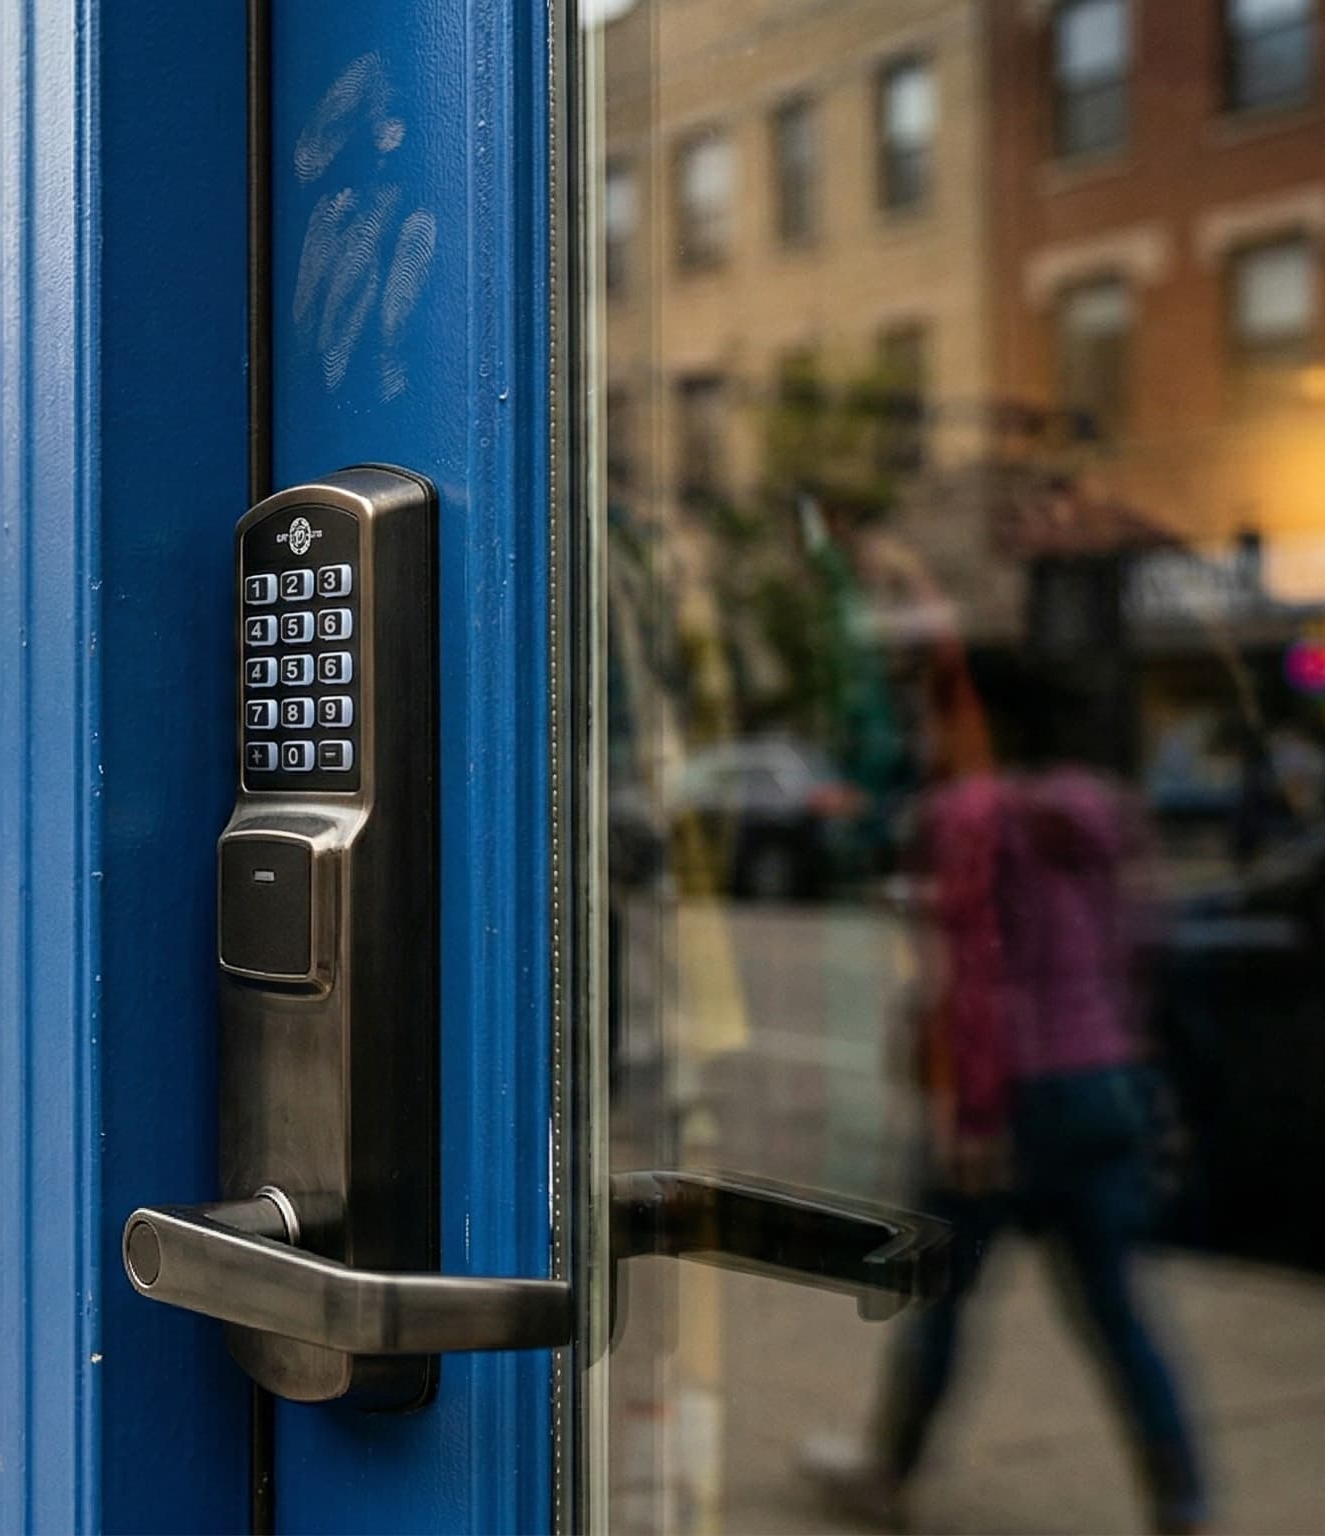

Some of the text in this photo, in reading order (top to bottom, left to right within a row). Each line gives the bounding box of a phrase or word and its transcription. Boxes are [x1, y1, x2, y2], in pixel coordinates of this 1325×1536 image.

[252, 572, 336, 597] 1 2 3
[251, 615, 336, 639] 4 5 6
[251, 658, 336, 680] 4 5 6
[252, 702, 336, 722] 7 8 9
[288, 748, 299, 765] 0
